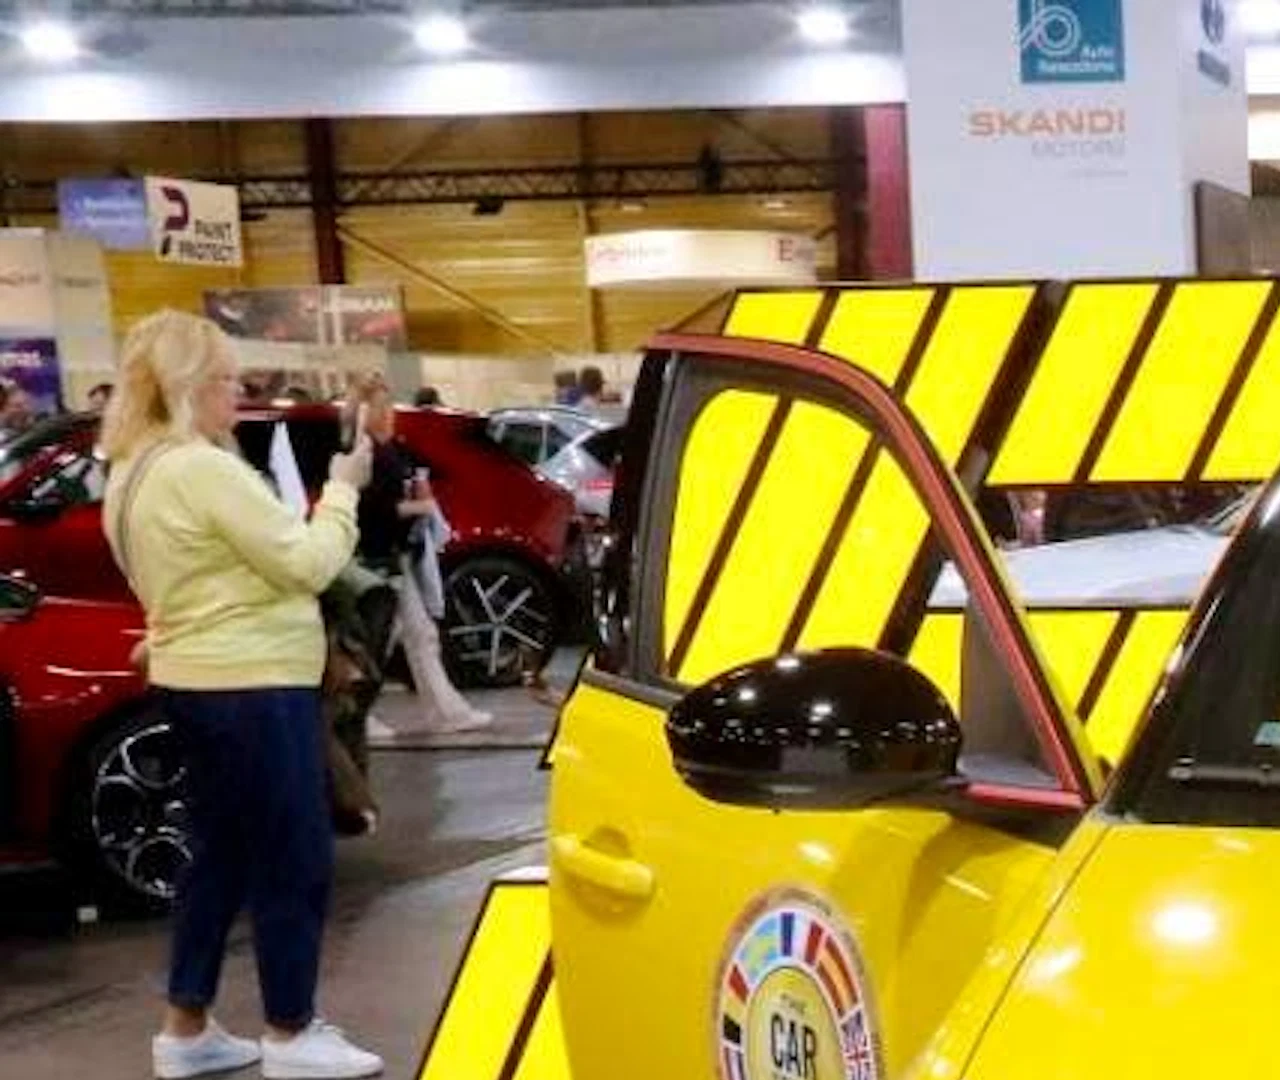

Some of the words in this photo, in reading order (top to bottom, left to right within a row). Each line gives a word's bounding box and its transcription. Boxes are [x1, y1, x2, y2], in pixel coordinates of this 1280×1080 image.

[969, 110, 1126, 136] SKANDI
[195, 220, 232, 240] PAINT
[180, 240, 236, 261] PROTECT
